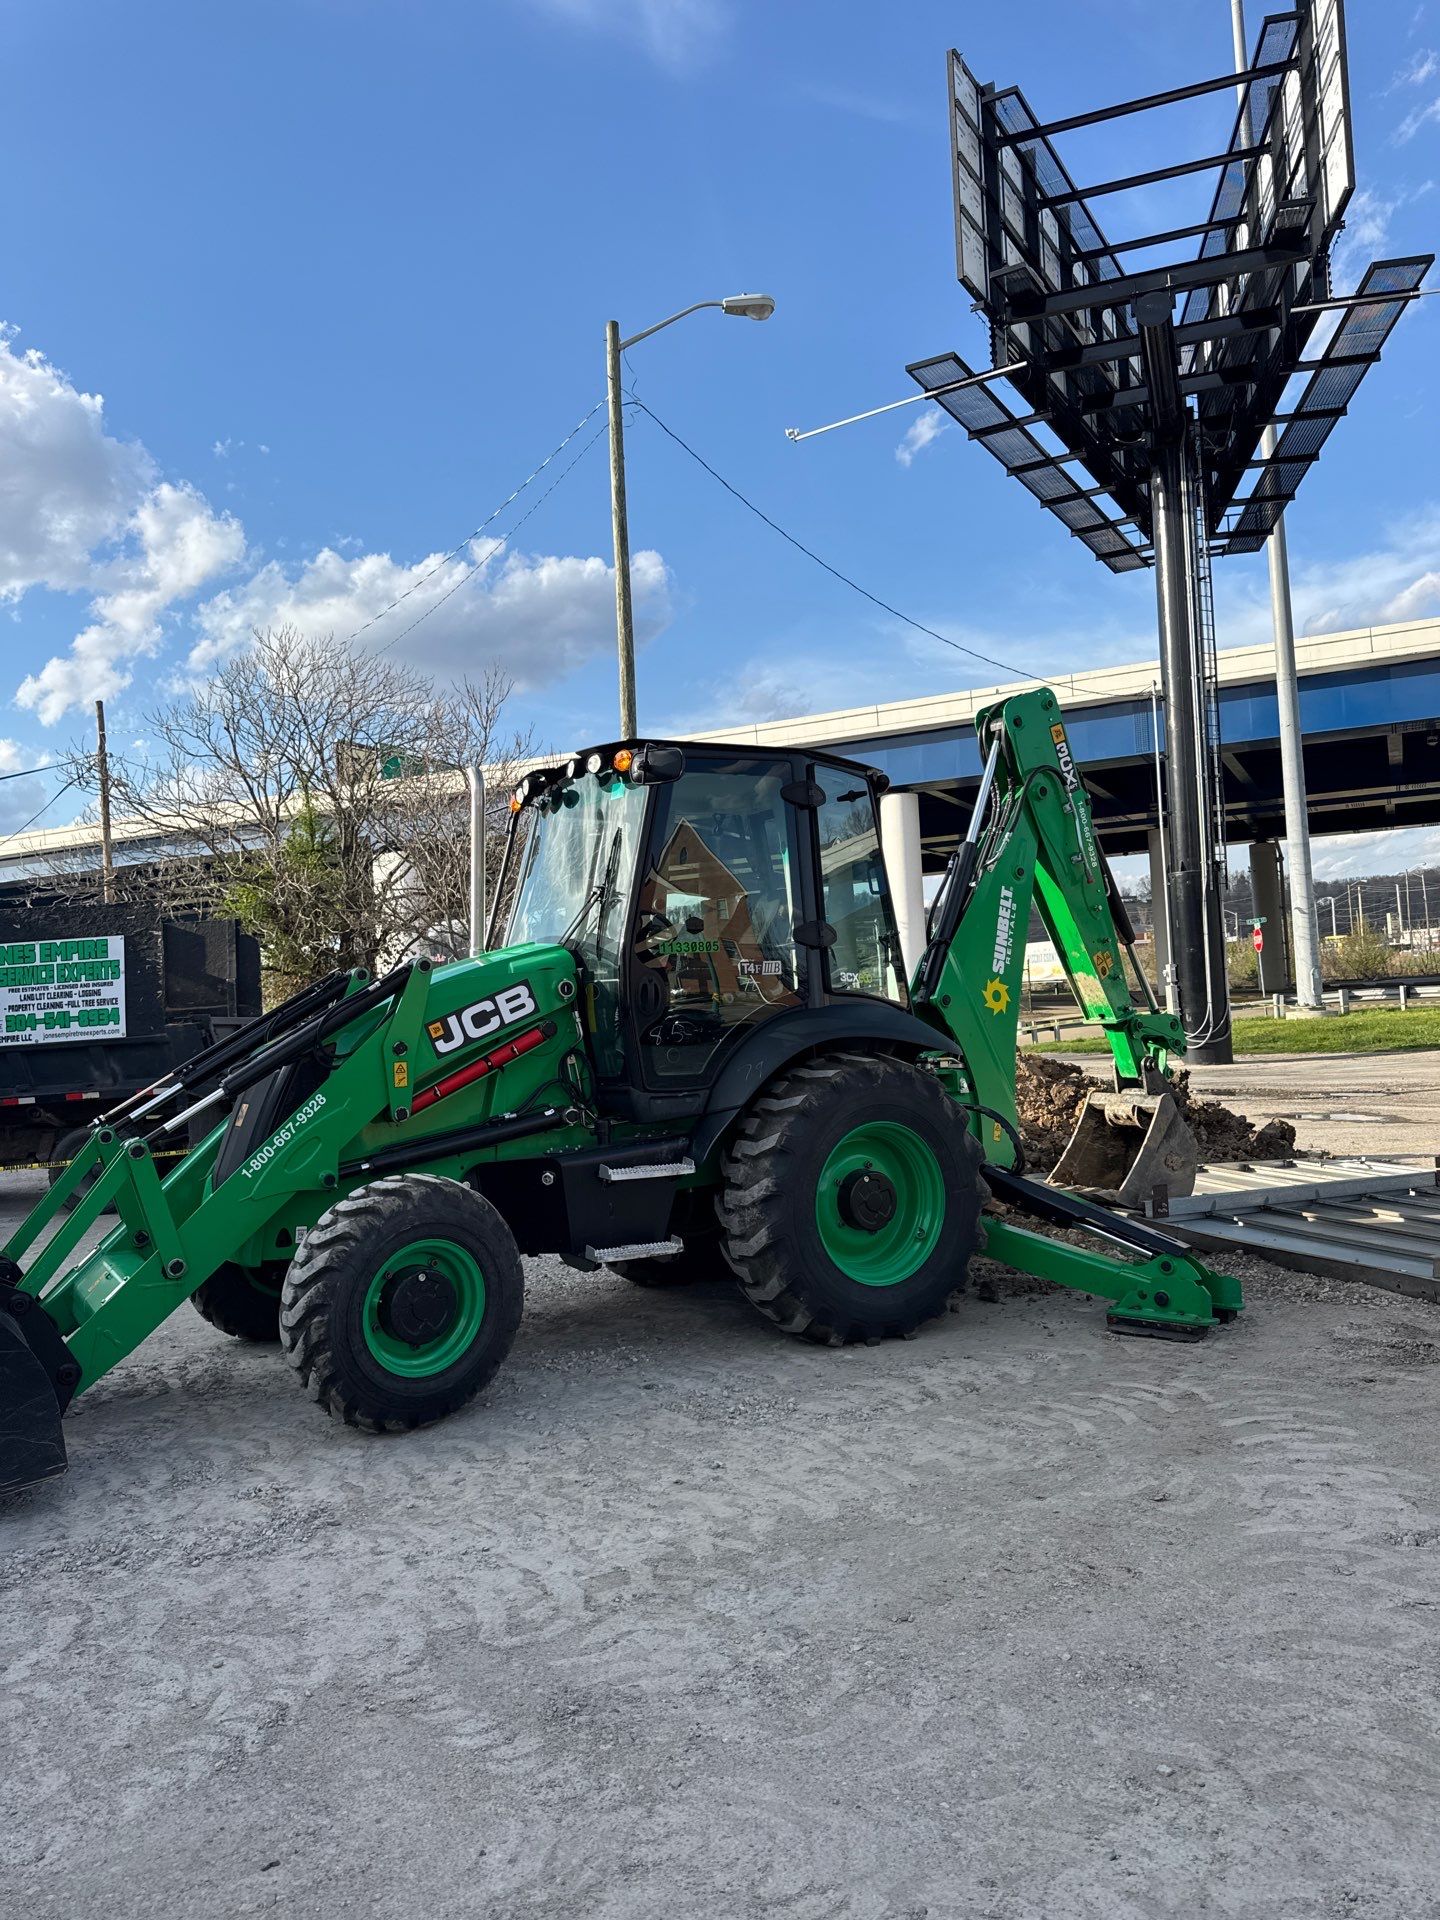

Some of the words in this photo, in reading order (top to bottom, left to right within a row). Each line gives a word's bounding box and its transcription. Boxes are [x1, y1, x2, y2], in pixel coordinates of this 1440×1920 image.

[1056, 742, 1077, 786] 3CX
[1077, 801, 1098, 868] 1-800-667-9328
[992, 885, 1013, 975] SUNBELT
[1005, 903, 1017, 965] RENTALS
[40, 938, 108, 963] EMPIRE
[661, 941, 720, 953] 11330805
[0, 964, 55, 988] SERVICE
[57, 960, 121, 983] EXPERTS
[742, 962, 762, 974] T4F
[840, 972, 859, 982] 3CX
[22, 984, 50, 993] ESTIMATES
[54, 982, 79, 991] LICENSED
[46, 990, 73, 1000] CLEARING
[78, 989, 102, 998] LOGGING
[8, 1003, 36, 1012] PROPERTY
[36, 1001, 64, 1011] CLEANING
[82, 998, 95, 1007] TREE
[96, 997, 119, 1006] SERVICE
[5, 1007, 120, 1033] 304-541-8934
[434, 984, 536, 1053] JCB
[21, 1033, 33, 1042] LLC
[43, 1029, 120, 1041] jonesempiretreeexperts.com
[241, 1093, 327, 1179] 1-800-667-9328
